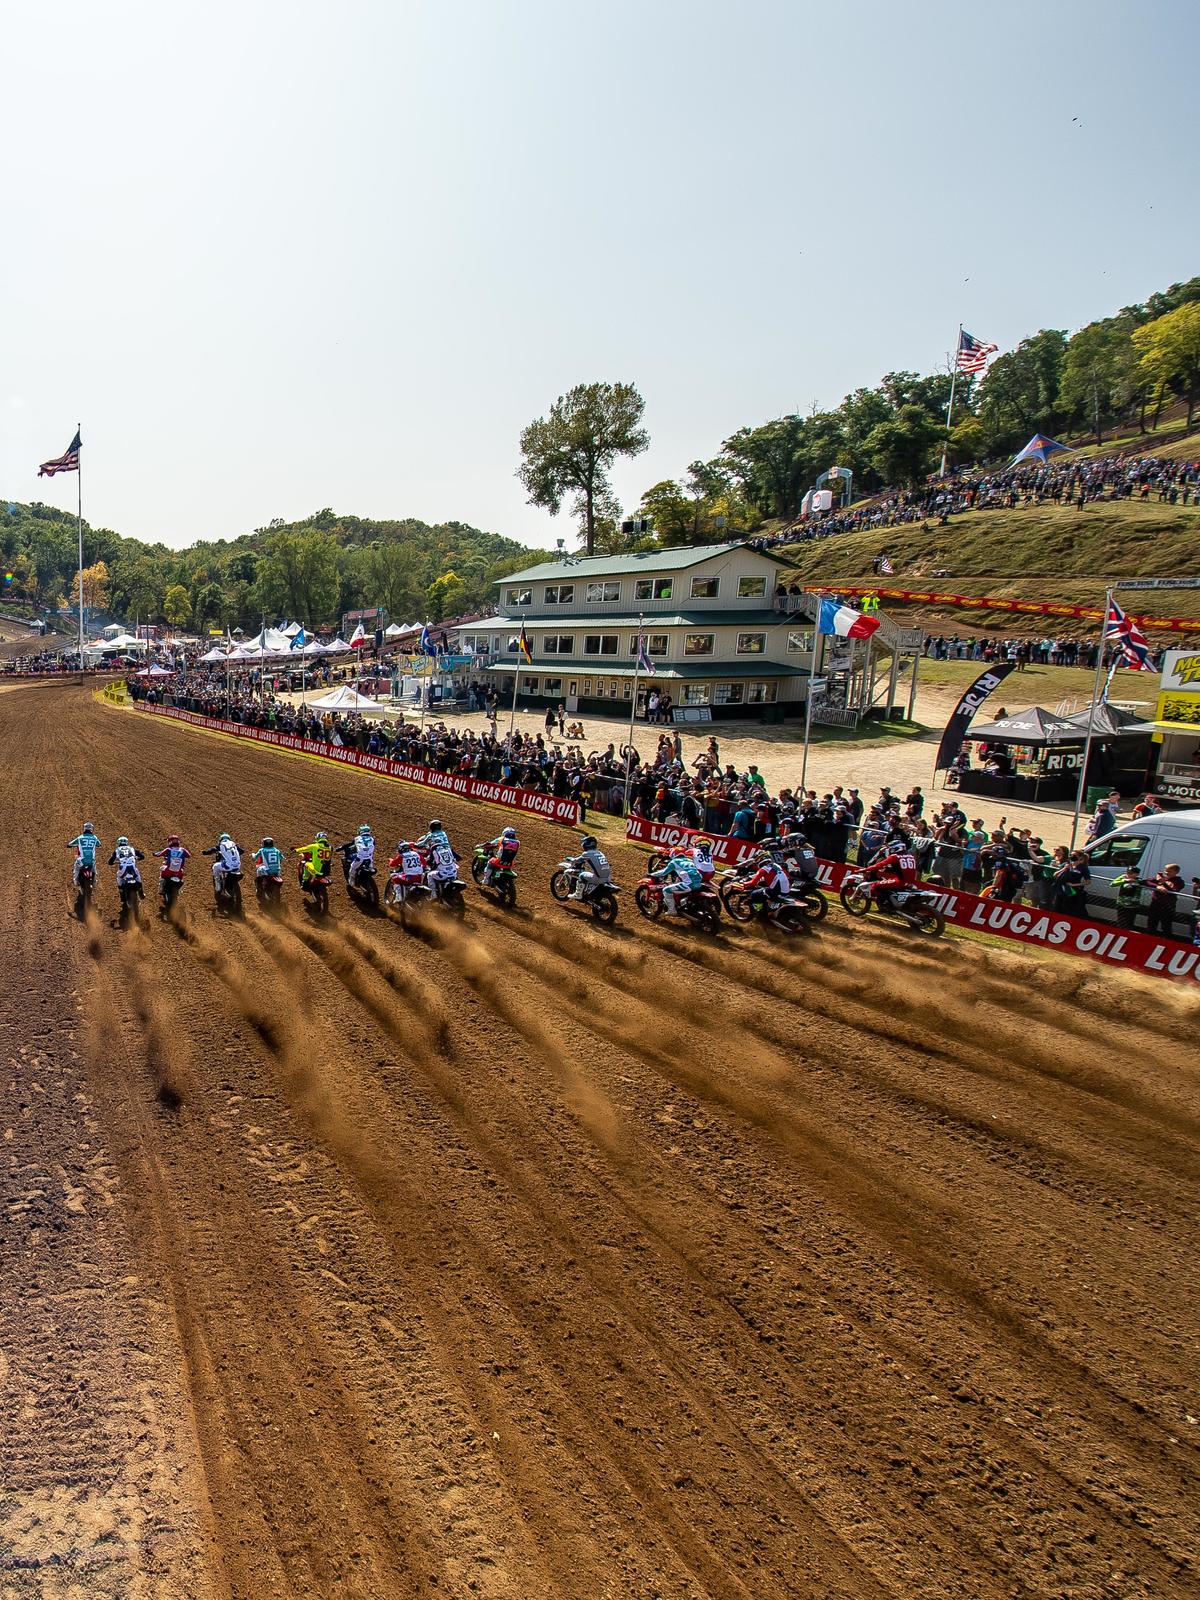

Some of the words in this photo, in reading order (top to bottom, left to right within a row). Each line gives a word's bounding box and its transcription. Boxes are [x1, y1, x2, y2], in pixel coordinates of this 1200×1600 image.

[280, 736, 294, 747] LUCAS
[294, 739, 302, 749] OIL
[303, 741, 319, 753] LUCAS
[320, 745, 328, 755] OIL
[329, 747, 347, 760] LUCAS
[347, 752, 356, 763] OIL
[359, 754, 378, 769] LUCAS
[378, 761, 388, 772] OIL
[390, 763, 413, 779] LUCAS
[413, 769, 425, 781] OIL
[427, 772, 453, 789] LUCAS
[454, 779, 467, 792] OIL
[470, 782, 501, 800] LUCAS
[501, 789, 517, 804] OIL
[521, 793, 556, 814] LUCAS
[556, 802, 575, 820] OIL
[81, 838, 94, 848] 35
[267, 852, 277, 863] 6
[814, 864, 834, 885] IL
[970, 903, 1071, 944] LUCAS
[1076, 928, 1128, 961] OIL
[1144, 945, 1200, 982] LU
